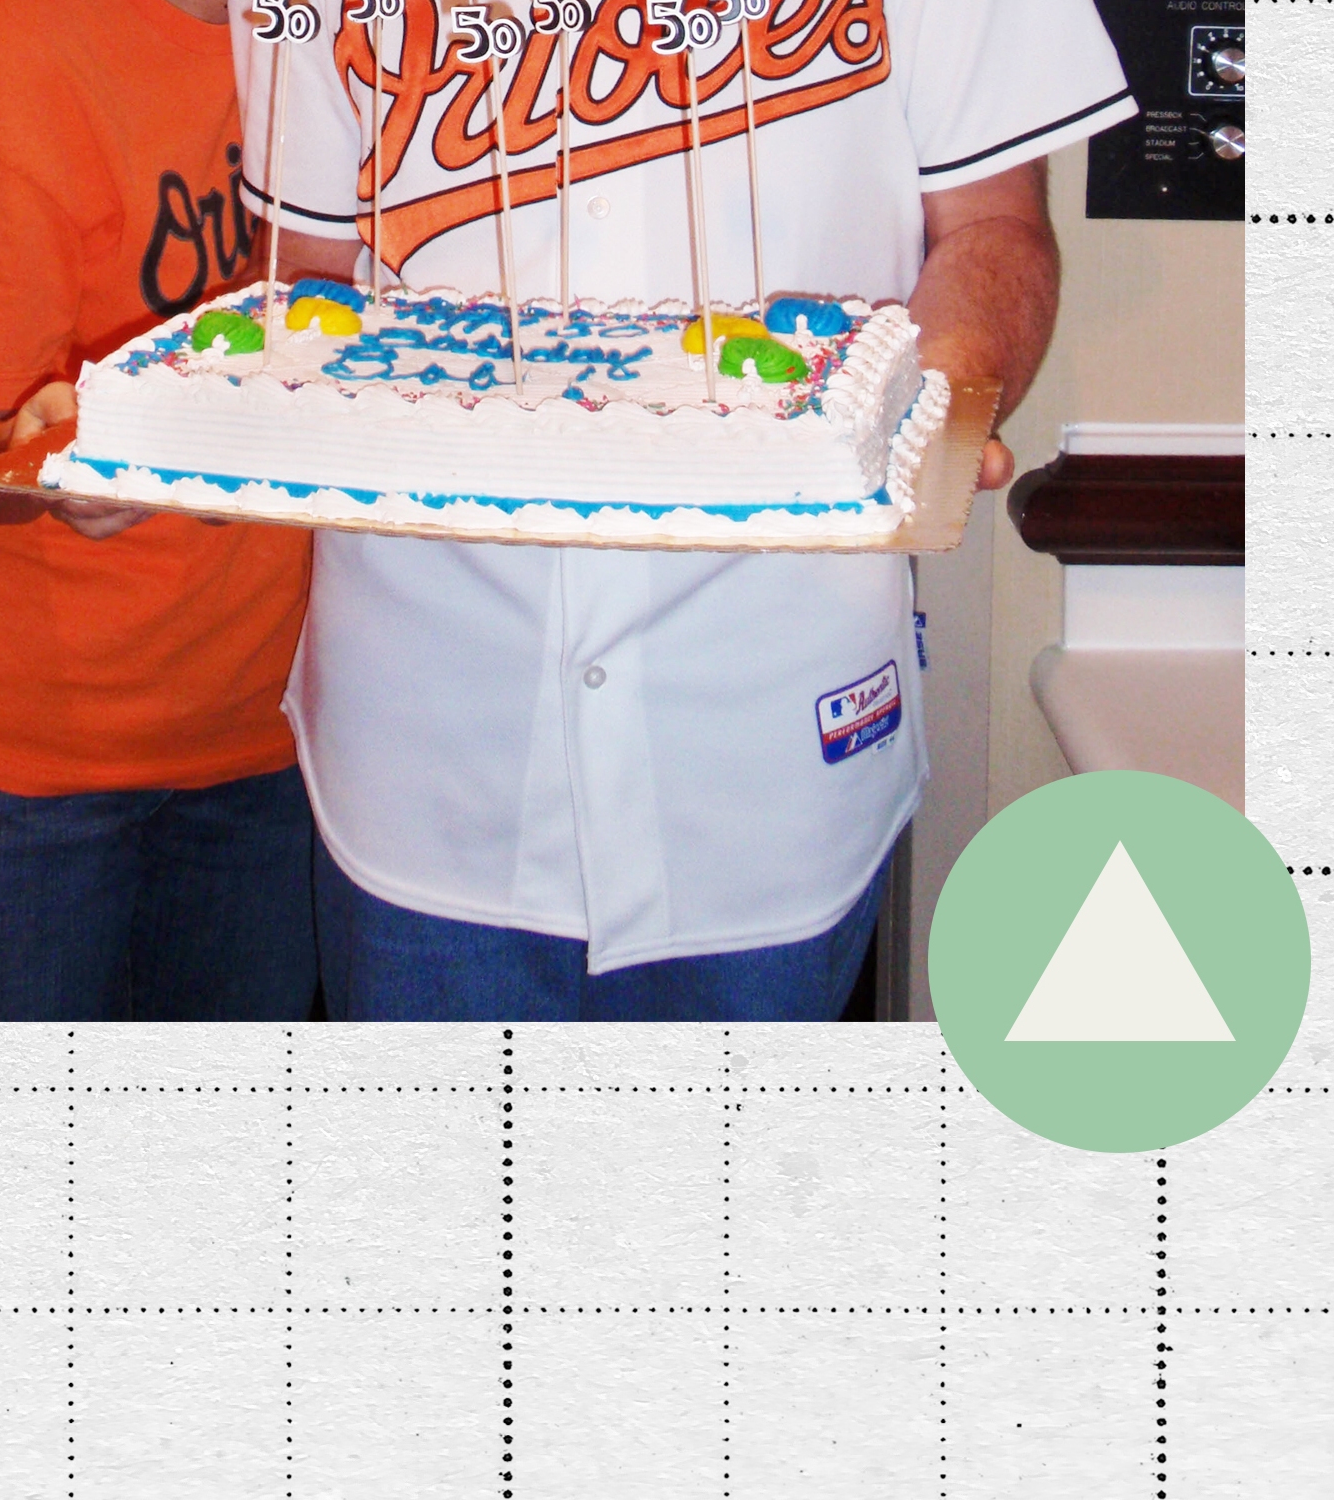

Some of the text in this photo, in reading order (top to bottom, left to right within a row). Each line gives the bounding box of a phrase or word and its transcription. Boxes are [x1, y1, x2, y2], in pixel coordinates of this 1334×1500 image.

[450, 5, 526, 64] 50
[1166, 1, 1197, 11] AUDIO
[140, 142, 253, 318] Ori
